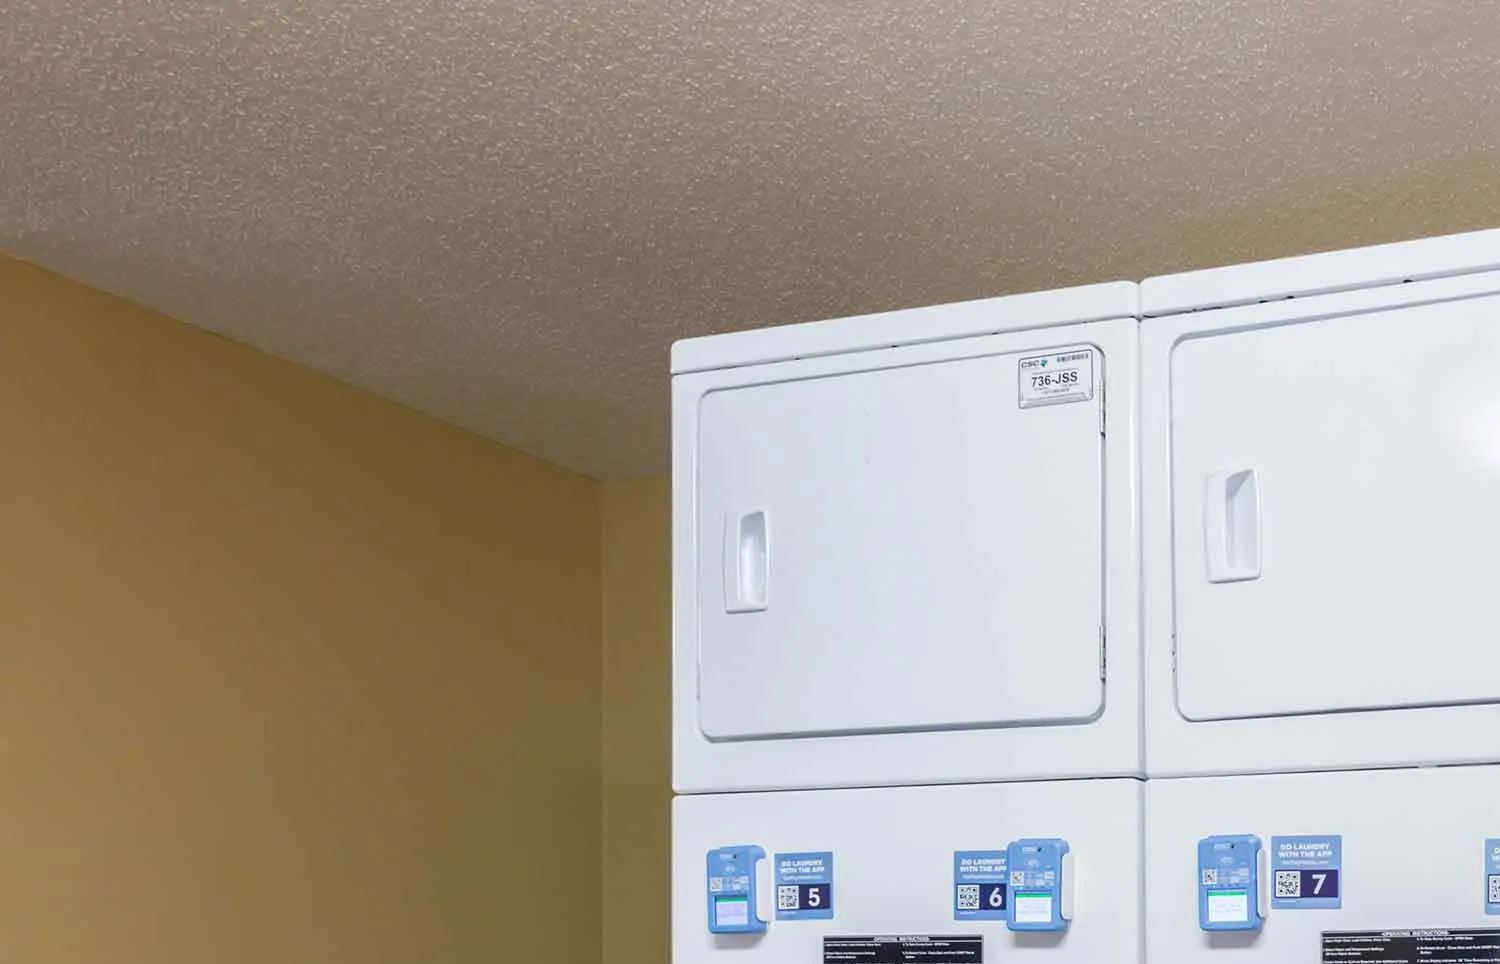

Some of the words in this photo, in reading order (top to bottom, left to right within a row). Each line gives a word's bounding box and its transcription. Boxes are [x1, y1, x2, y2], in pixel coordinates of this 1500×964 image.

[1031, 371, 1078, 387] 736-JSS
[1312, 874, 1326, 895] 7
[808, 888, 821, 907] 5
[989, 887, 1002, 907] 6
